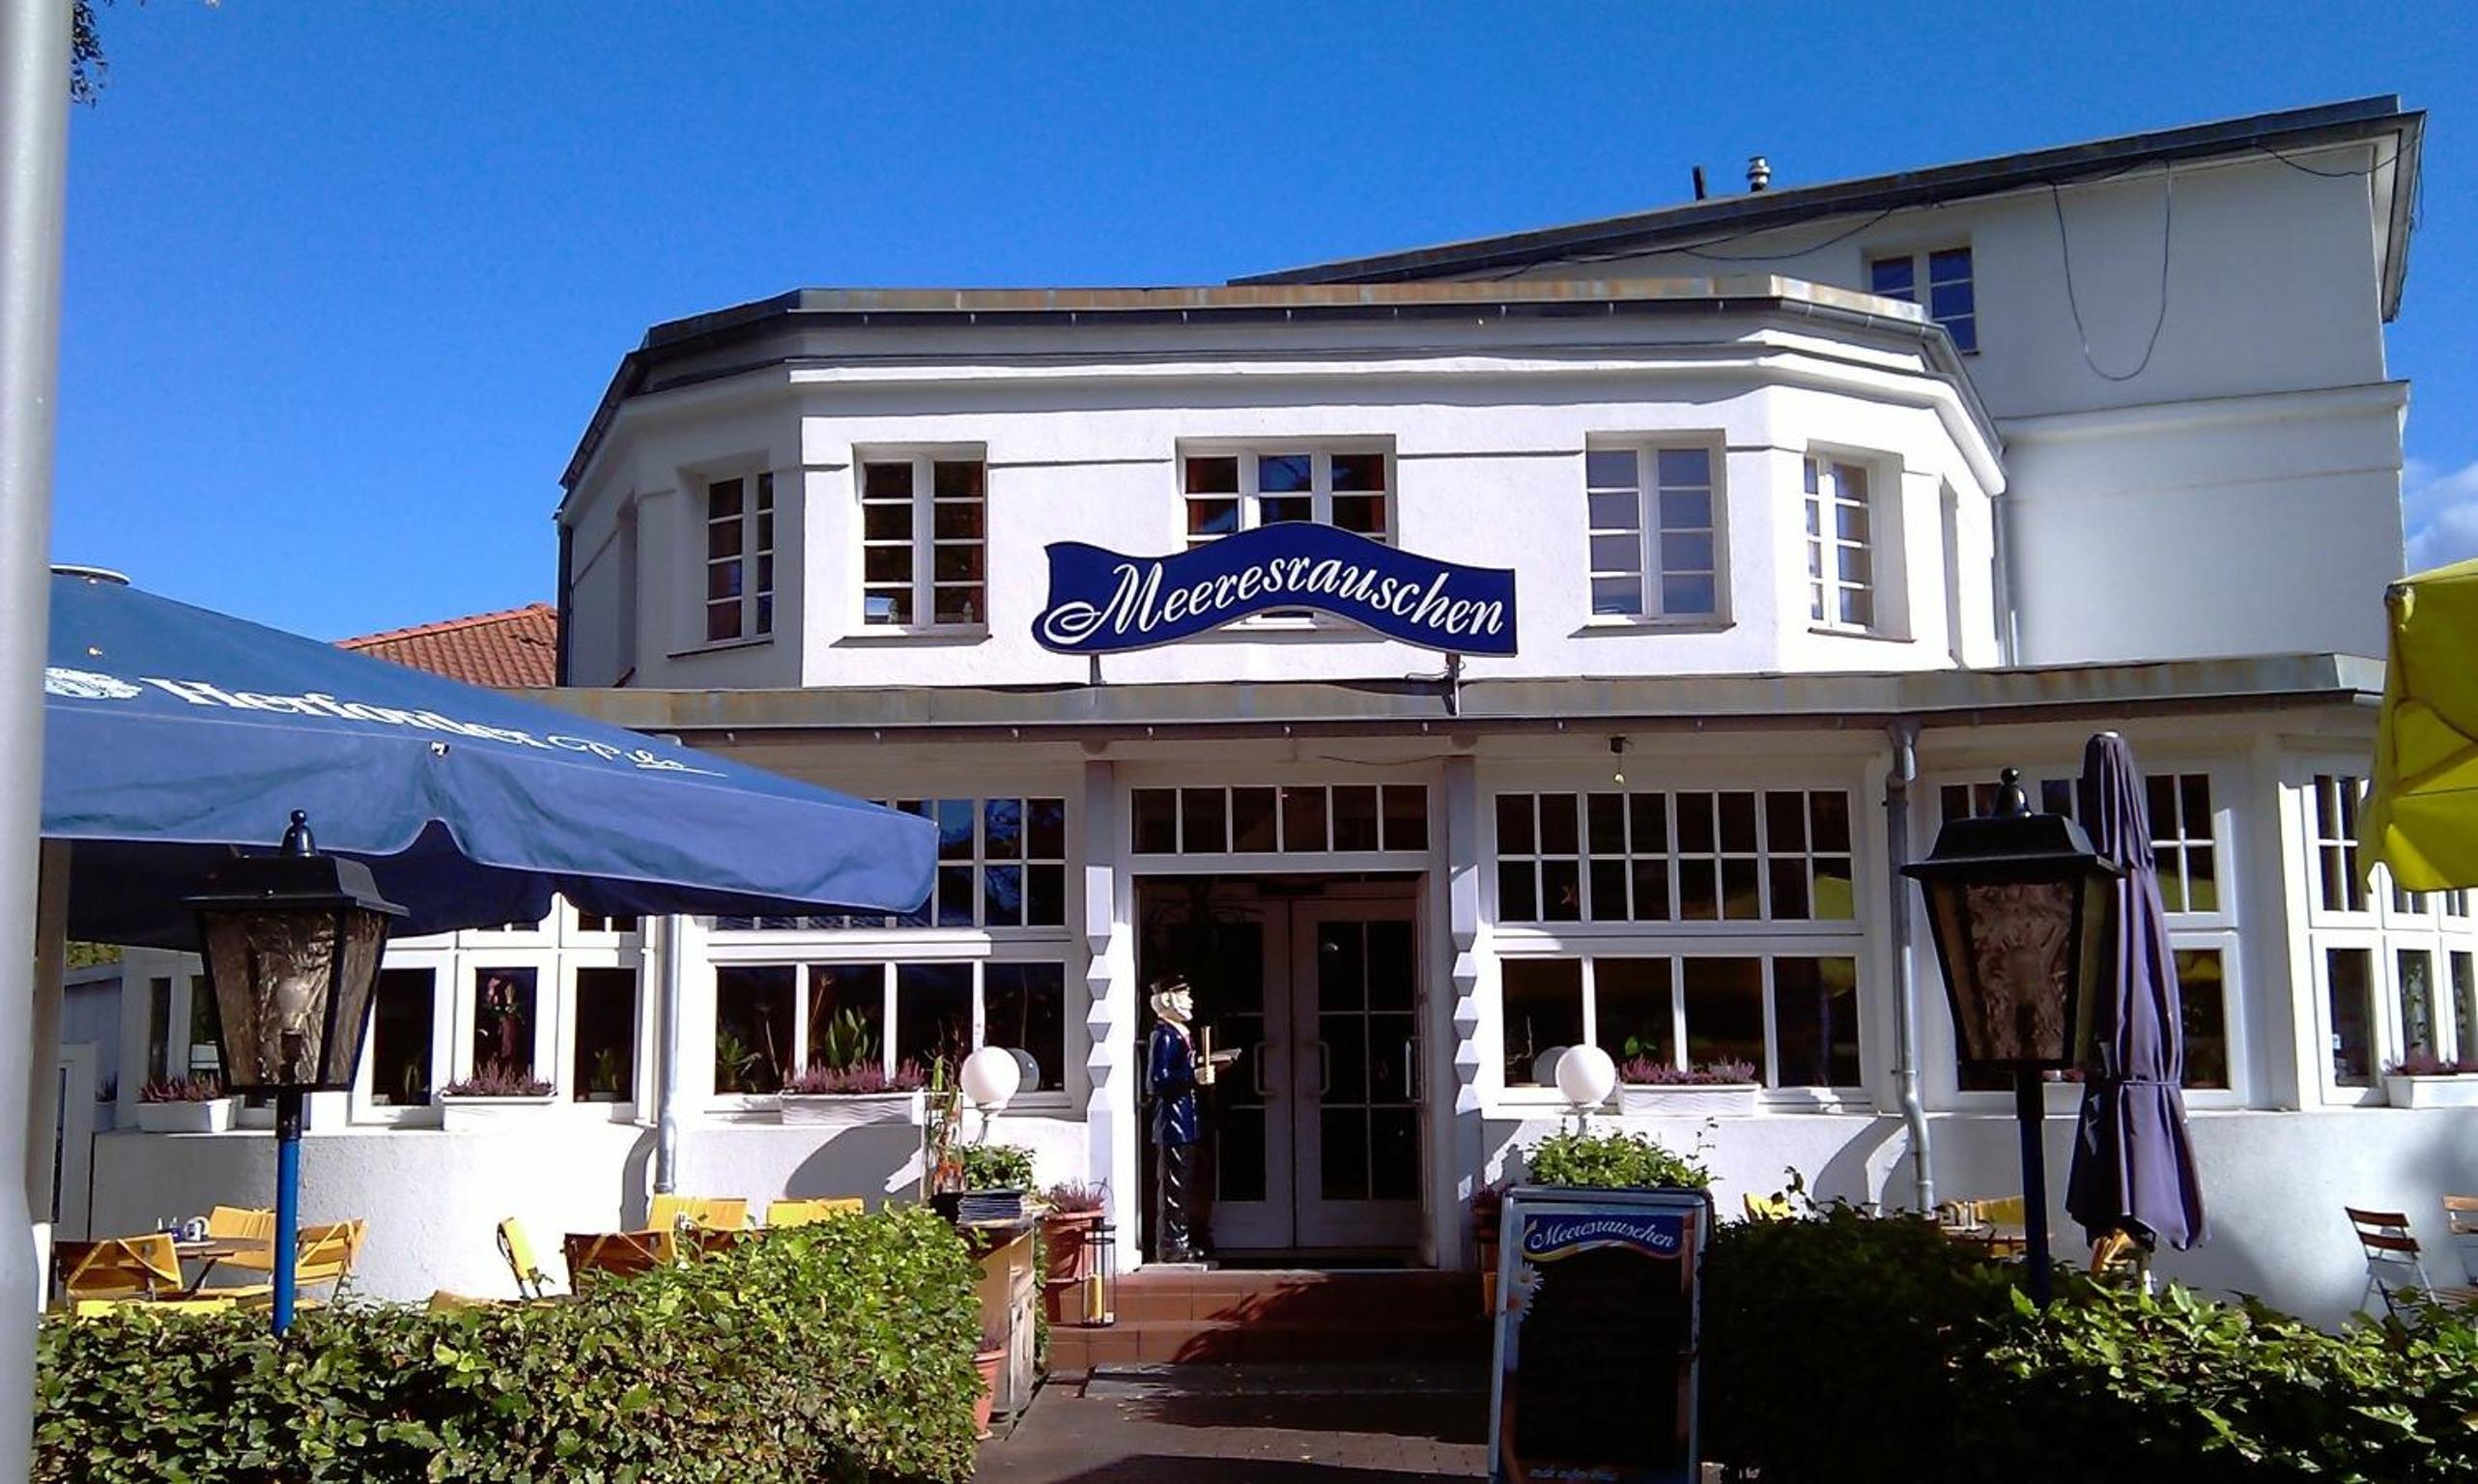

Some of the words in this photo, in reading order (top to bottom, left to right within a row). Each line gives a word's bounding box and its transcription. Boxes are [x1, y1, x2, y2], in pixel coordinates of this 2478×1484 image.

[1044, 556, 1504, 644] Meeresrauschen
[139, 676, 553, 750] Herforder
[547, 735, 726, 778] Pils
[1530, 1220, 1675, 1249] Meeresrauschen
